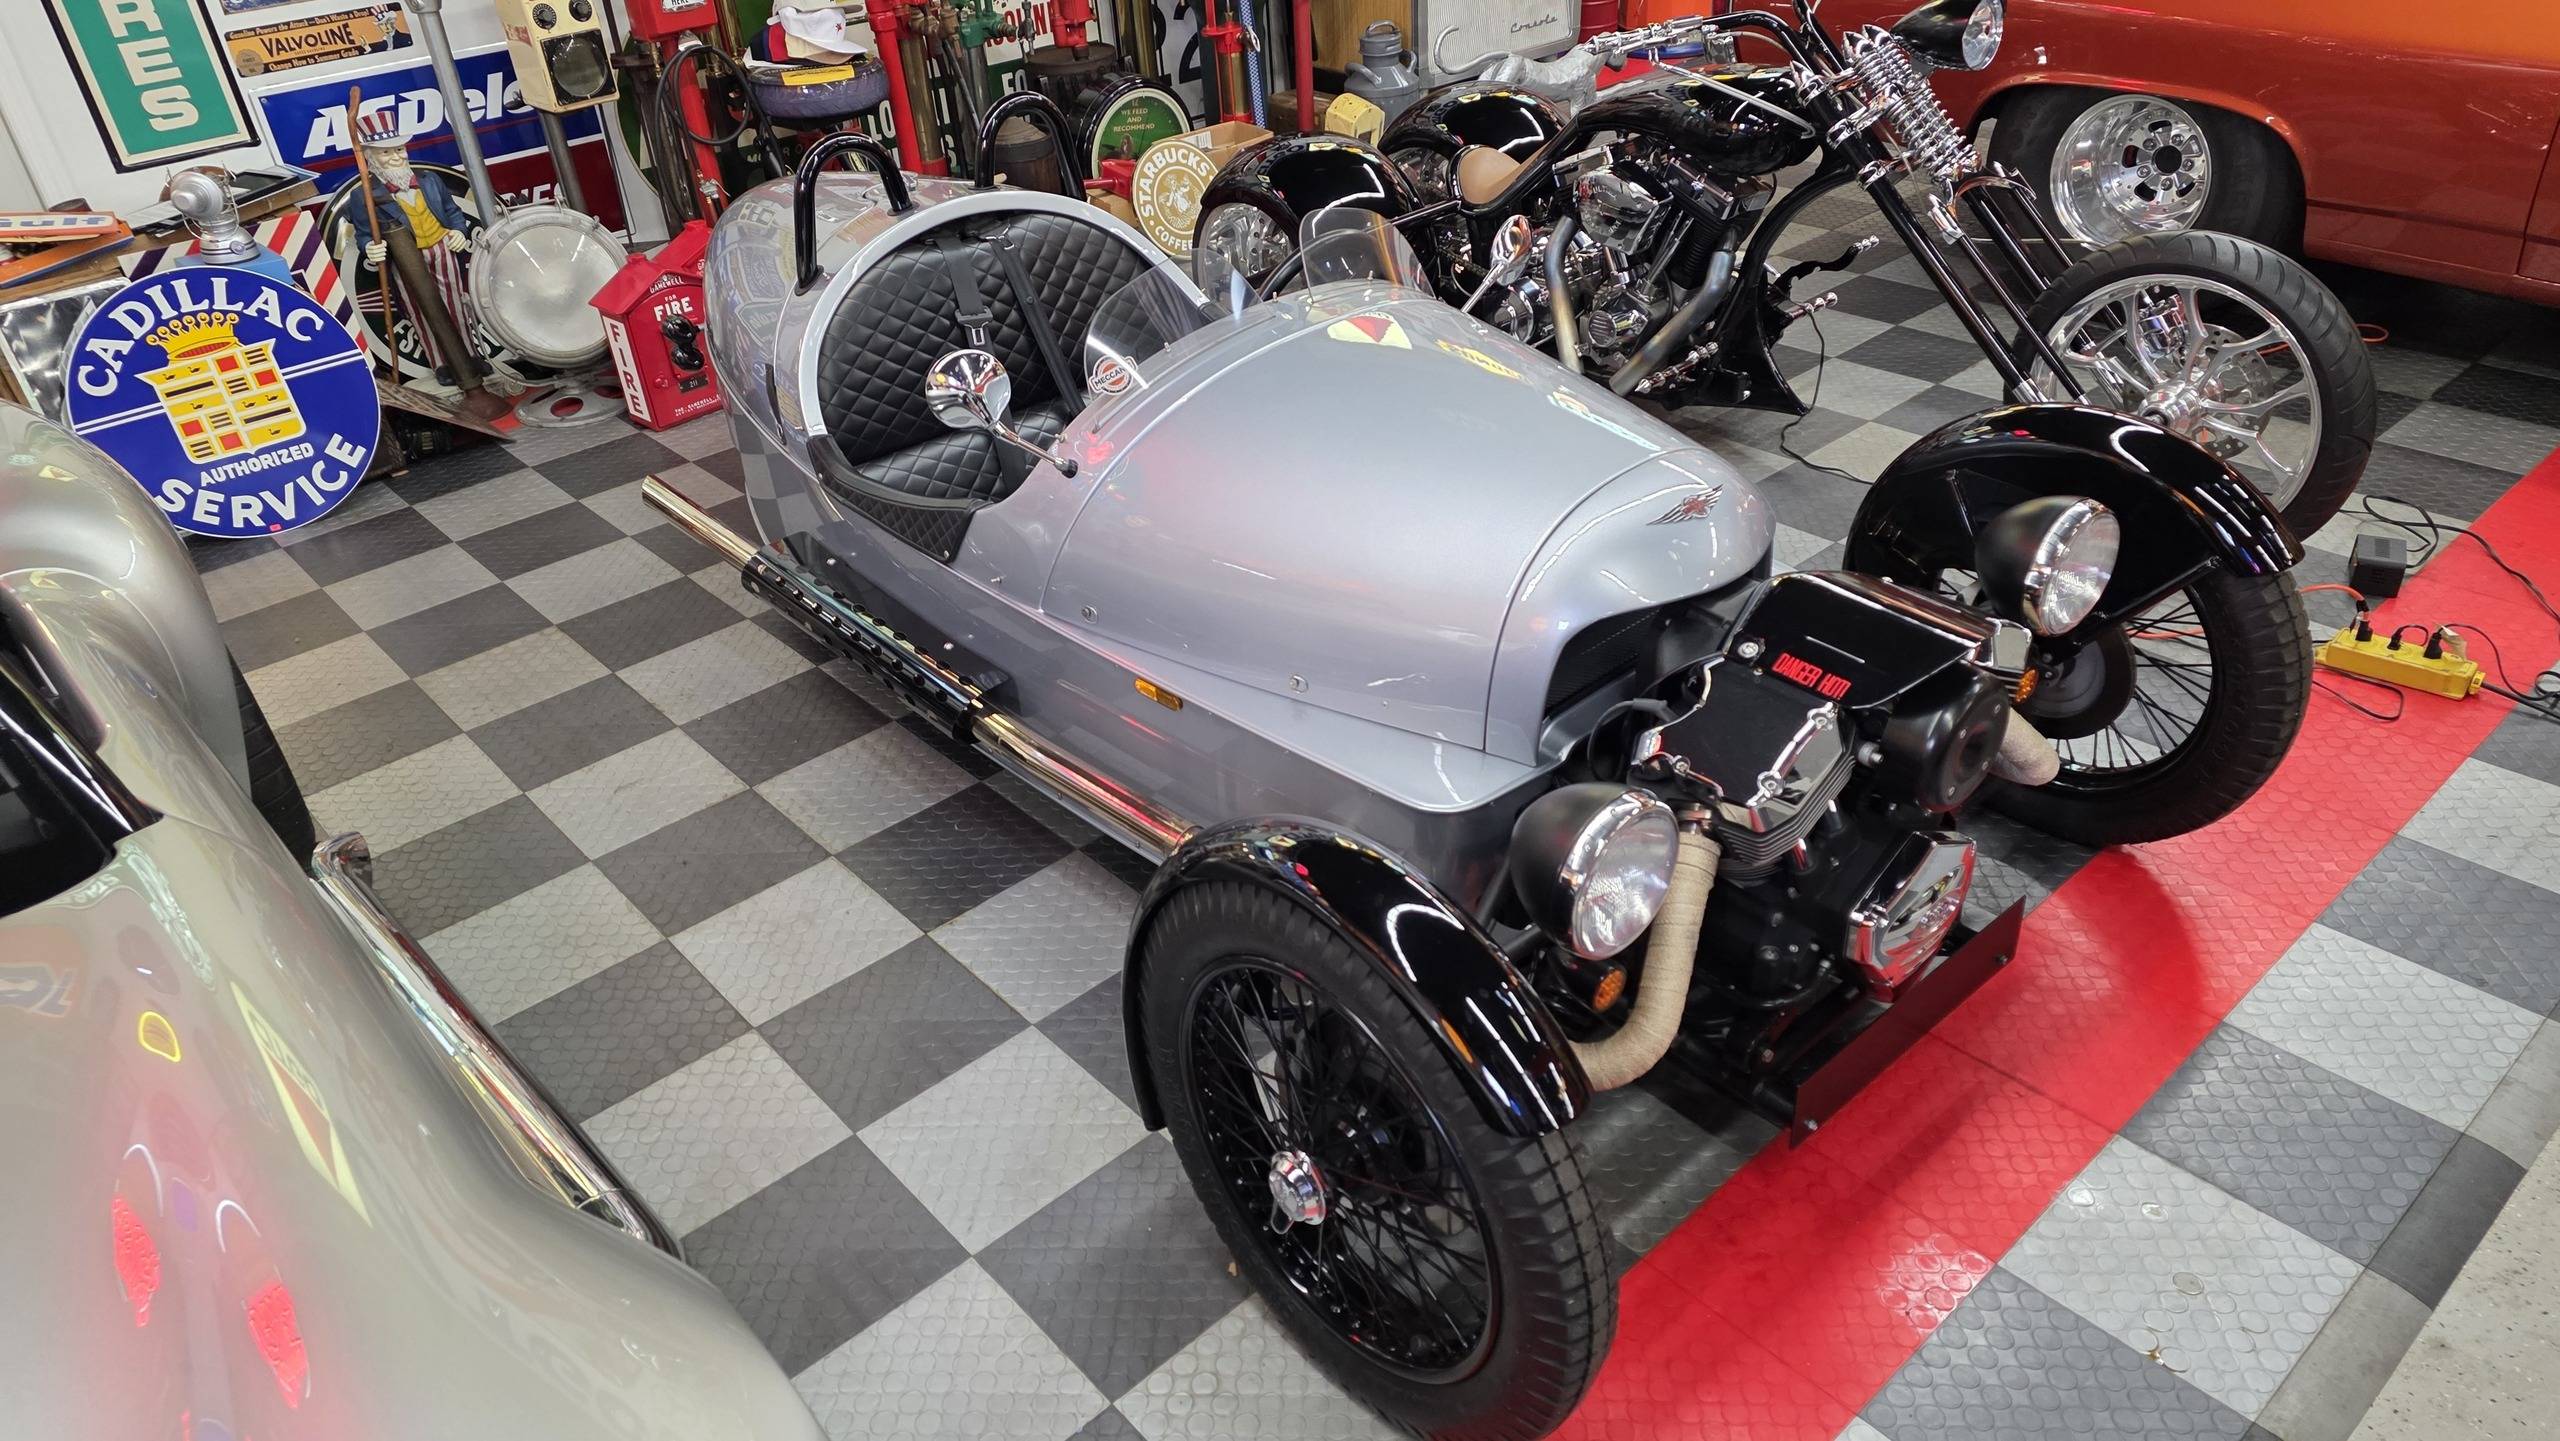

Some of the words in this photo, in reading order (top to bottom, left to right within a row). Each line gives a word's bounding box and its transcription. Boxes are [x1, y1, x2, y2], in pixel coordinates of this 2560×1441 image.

[260, 22, 356, 58] VALVOLINE
[1139, 147, 1210, 217] STARBUCKS
[78, 277, 325, 397] CADILLAC
[653, 297, 694, 322] FIRE
[609, 322, 644, 416] FIRE
[154, 432, 368, 529] SERVICE
[200, 442, 315, 488] AUTHORIZED
[1771, 652, 1823, 688] DANGER
